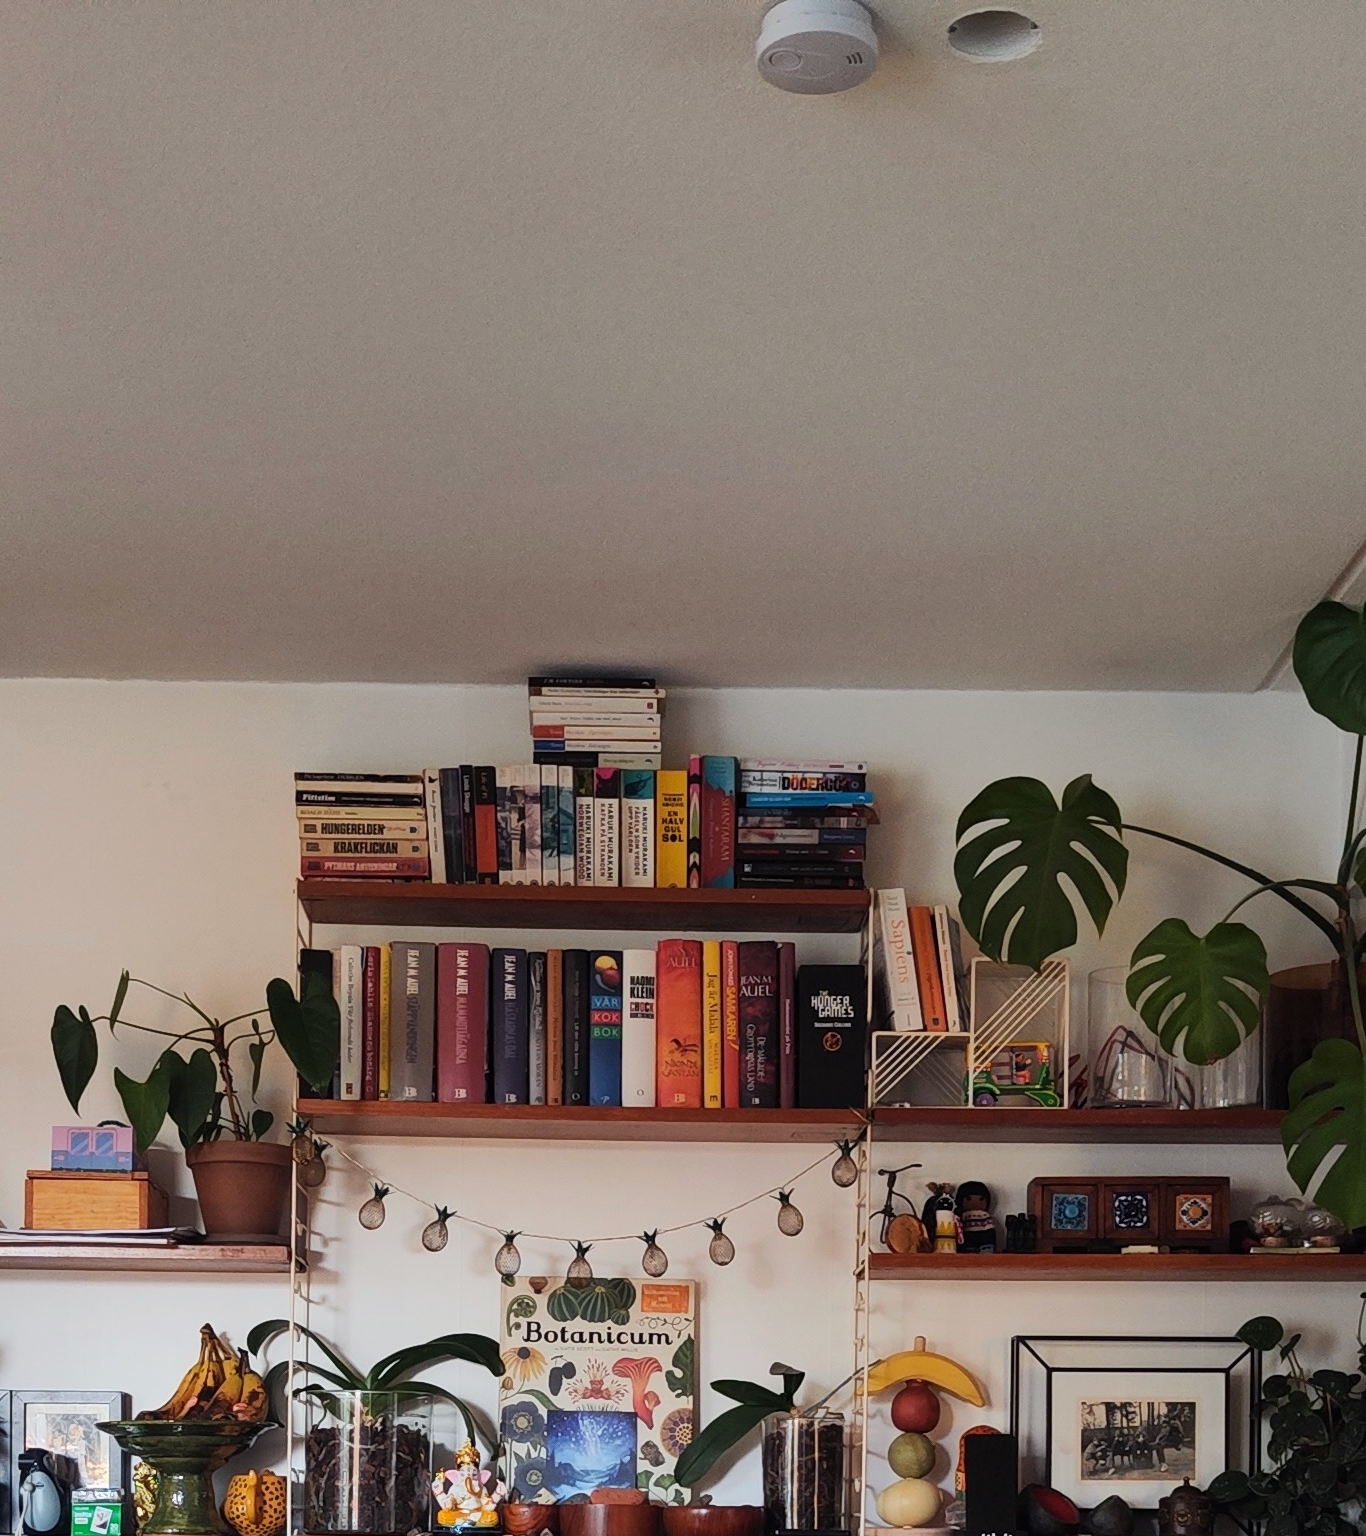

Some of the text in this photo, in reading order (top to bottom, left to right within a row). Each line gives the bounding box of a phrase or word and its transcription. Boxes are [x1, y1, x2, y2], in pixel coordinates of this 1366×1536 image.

[661, 817, 684, 825] HALV
[321, 823, 384, 835] HUNGERELDEN
[599, 828, 606, 838] PÅ
[721, 798, 730, 861] SHANTARAM
[661, 834, 684, 842] SOL
[888, 919, 910, 984] Sapiens
[407, 949, 419, 968] JEAN
[457, 949, 469, 968] JEAN
[504, 955, 517, 973] JEAN
[407, 968, 418, 977] M
[457, 968, 468, 977] M
[504, 973, 516, 981] M
[406, 977, 418, 996] AUEL
[456, 977, 468, 996] AUEL
[630, 976, 655, 986] NAOMI
[740, 975, 772, 986] JEAN M
[504, 982, 517, 1001] AUEL
[630, 986, 655, 999] KLEIN
[739, 986, 774, 997] AUEL
[594, 997, 619, 1007] VÅR
[706, 972, 719, 1034] Jag är Malala
[594, 1012, 619, 1022] KOK
[726, 986, 737, 1041] SAMLAREN
[818, 1006, 854, 1017] GAMES
[594, 1026, 619, 1037] BOK
[746, 1072, 756, 1091] LAND
[522, 1321, 673, 1345] Botanicum
